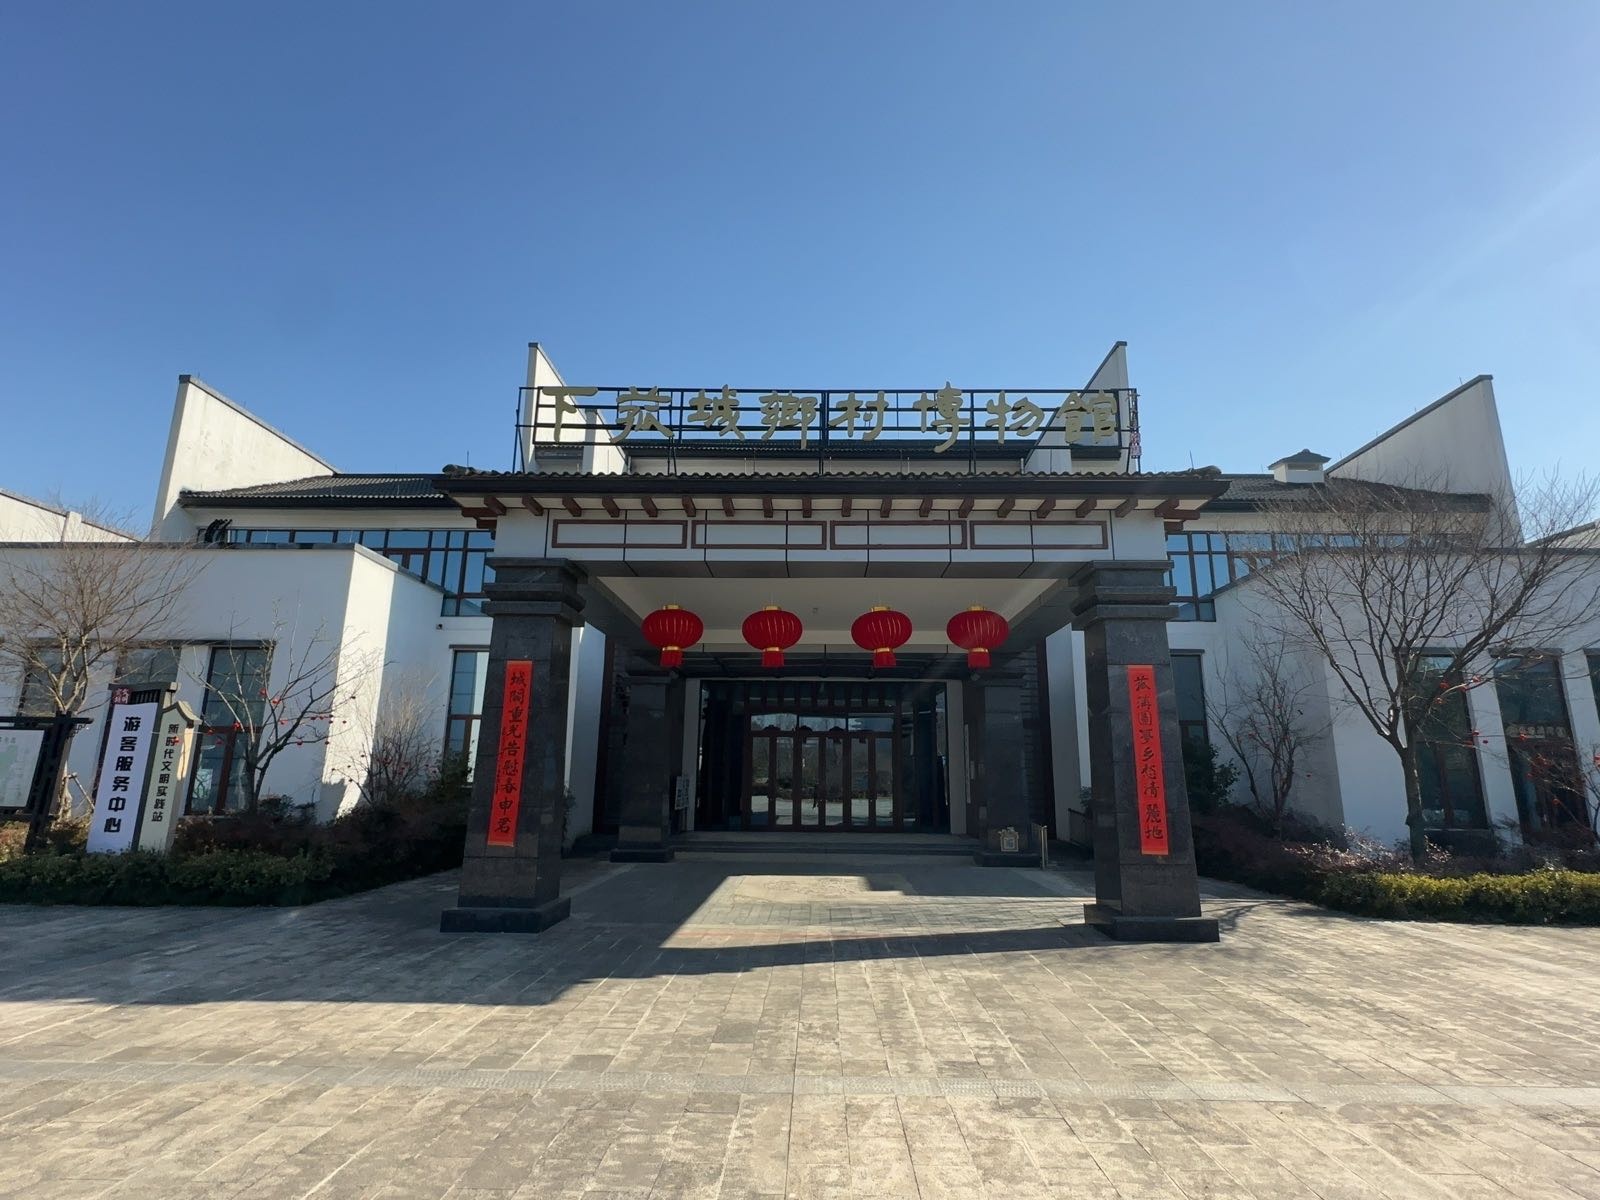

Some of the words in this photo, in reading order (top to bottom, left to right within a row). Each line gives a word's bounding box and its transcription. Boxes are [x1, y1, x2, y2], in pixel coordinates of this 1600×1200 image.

[104, 716, 141, 833] 游客服务中心
[151, 723, 179, 822] 新时代文明实践站
